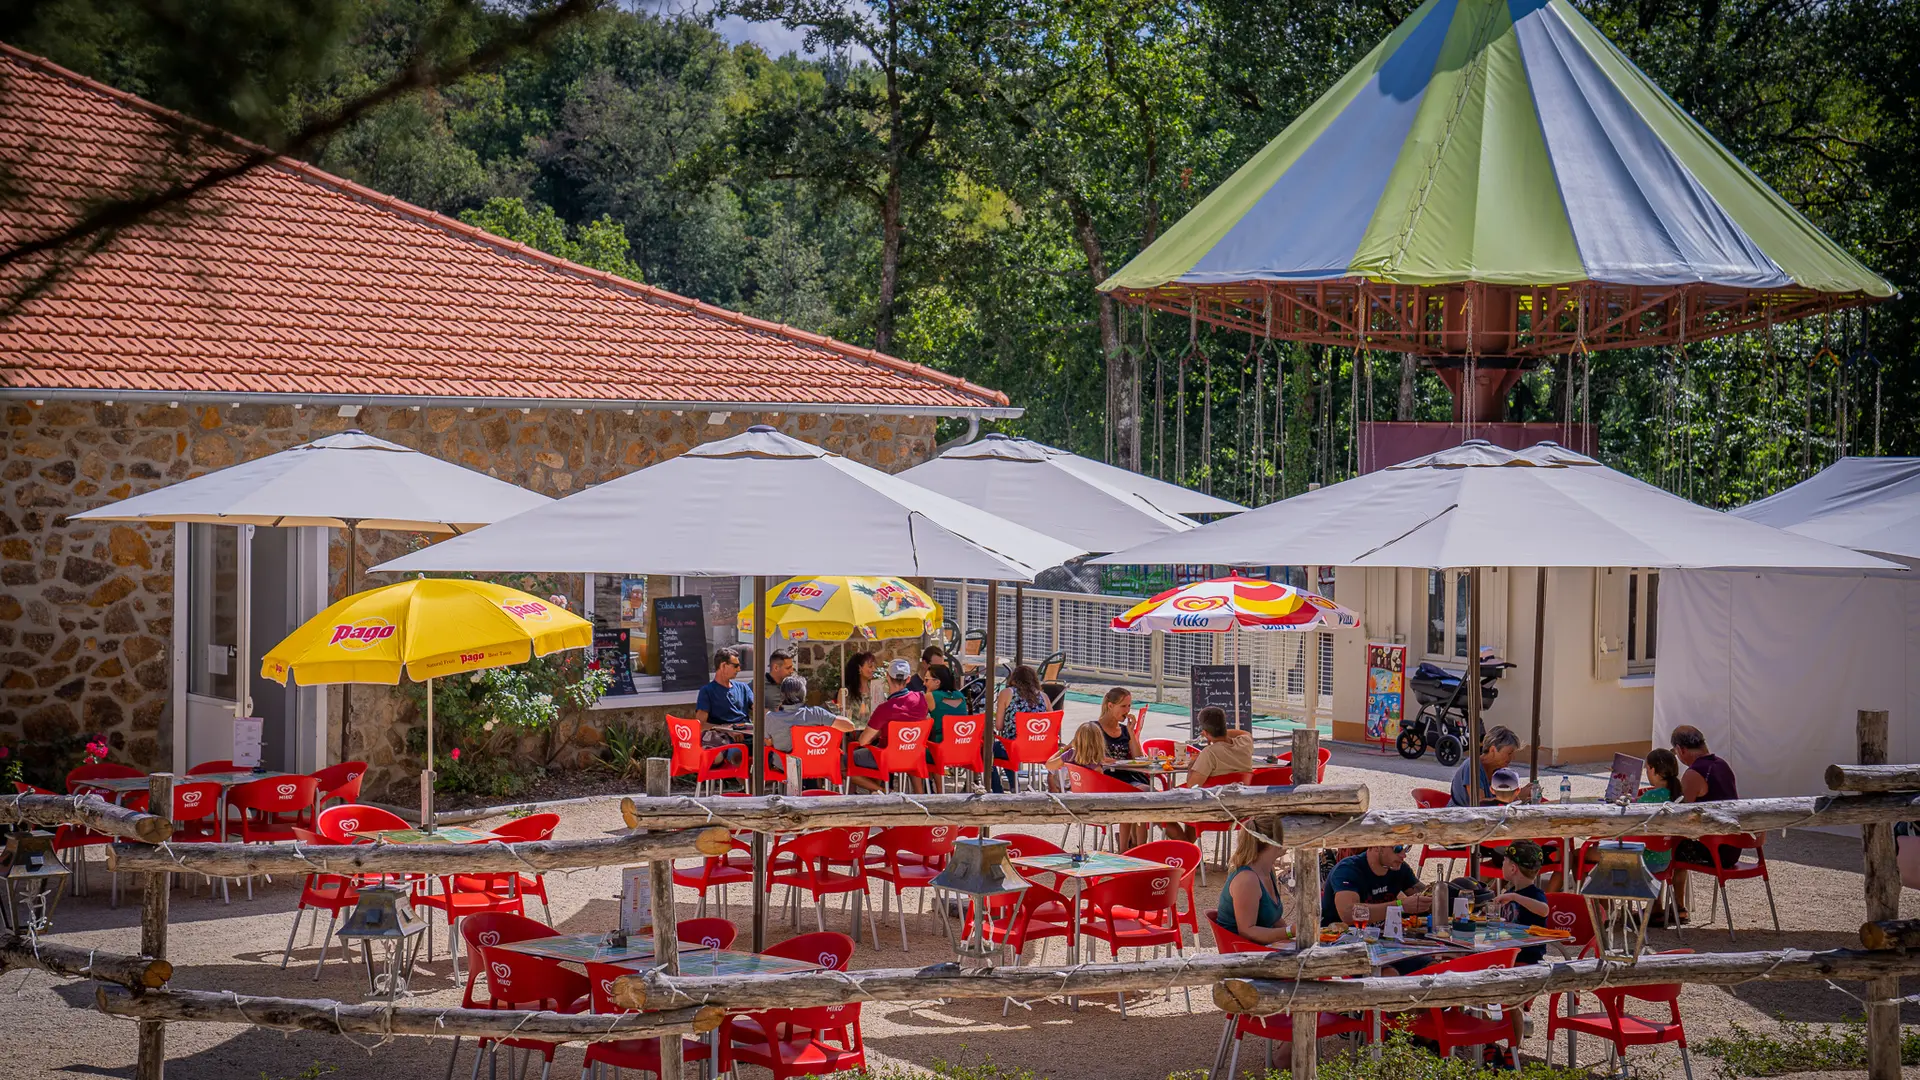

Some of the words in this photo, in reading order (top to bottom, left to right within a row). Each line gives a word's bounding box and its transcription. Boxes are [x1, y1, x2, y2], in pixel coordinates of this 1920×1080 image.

[1173, 614, 1209, 627] Miko
[426, 660, 443, 668] Natural
[497, 979, 511, 987] MIKO
